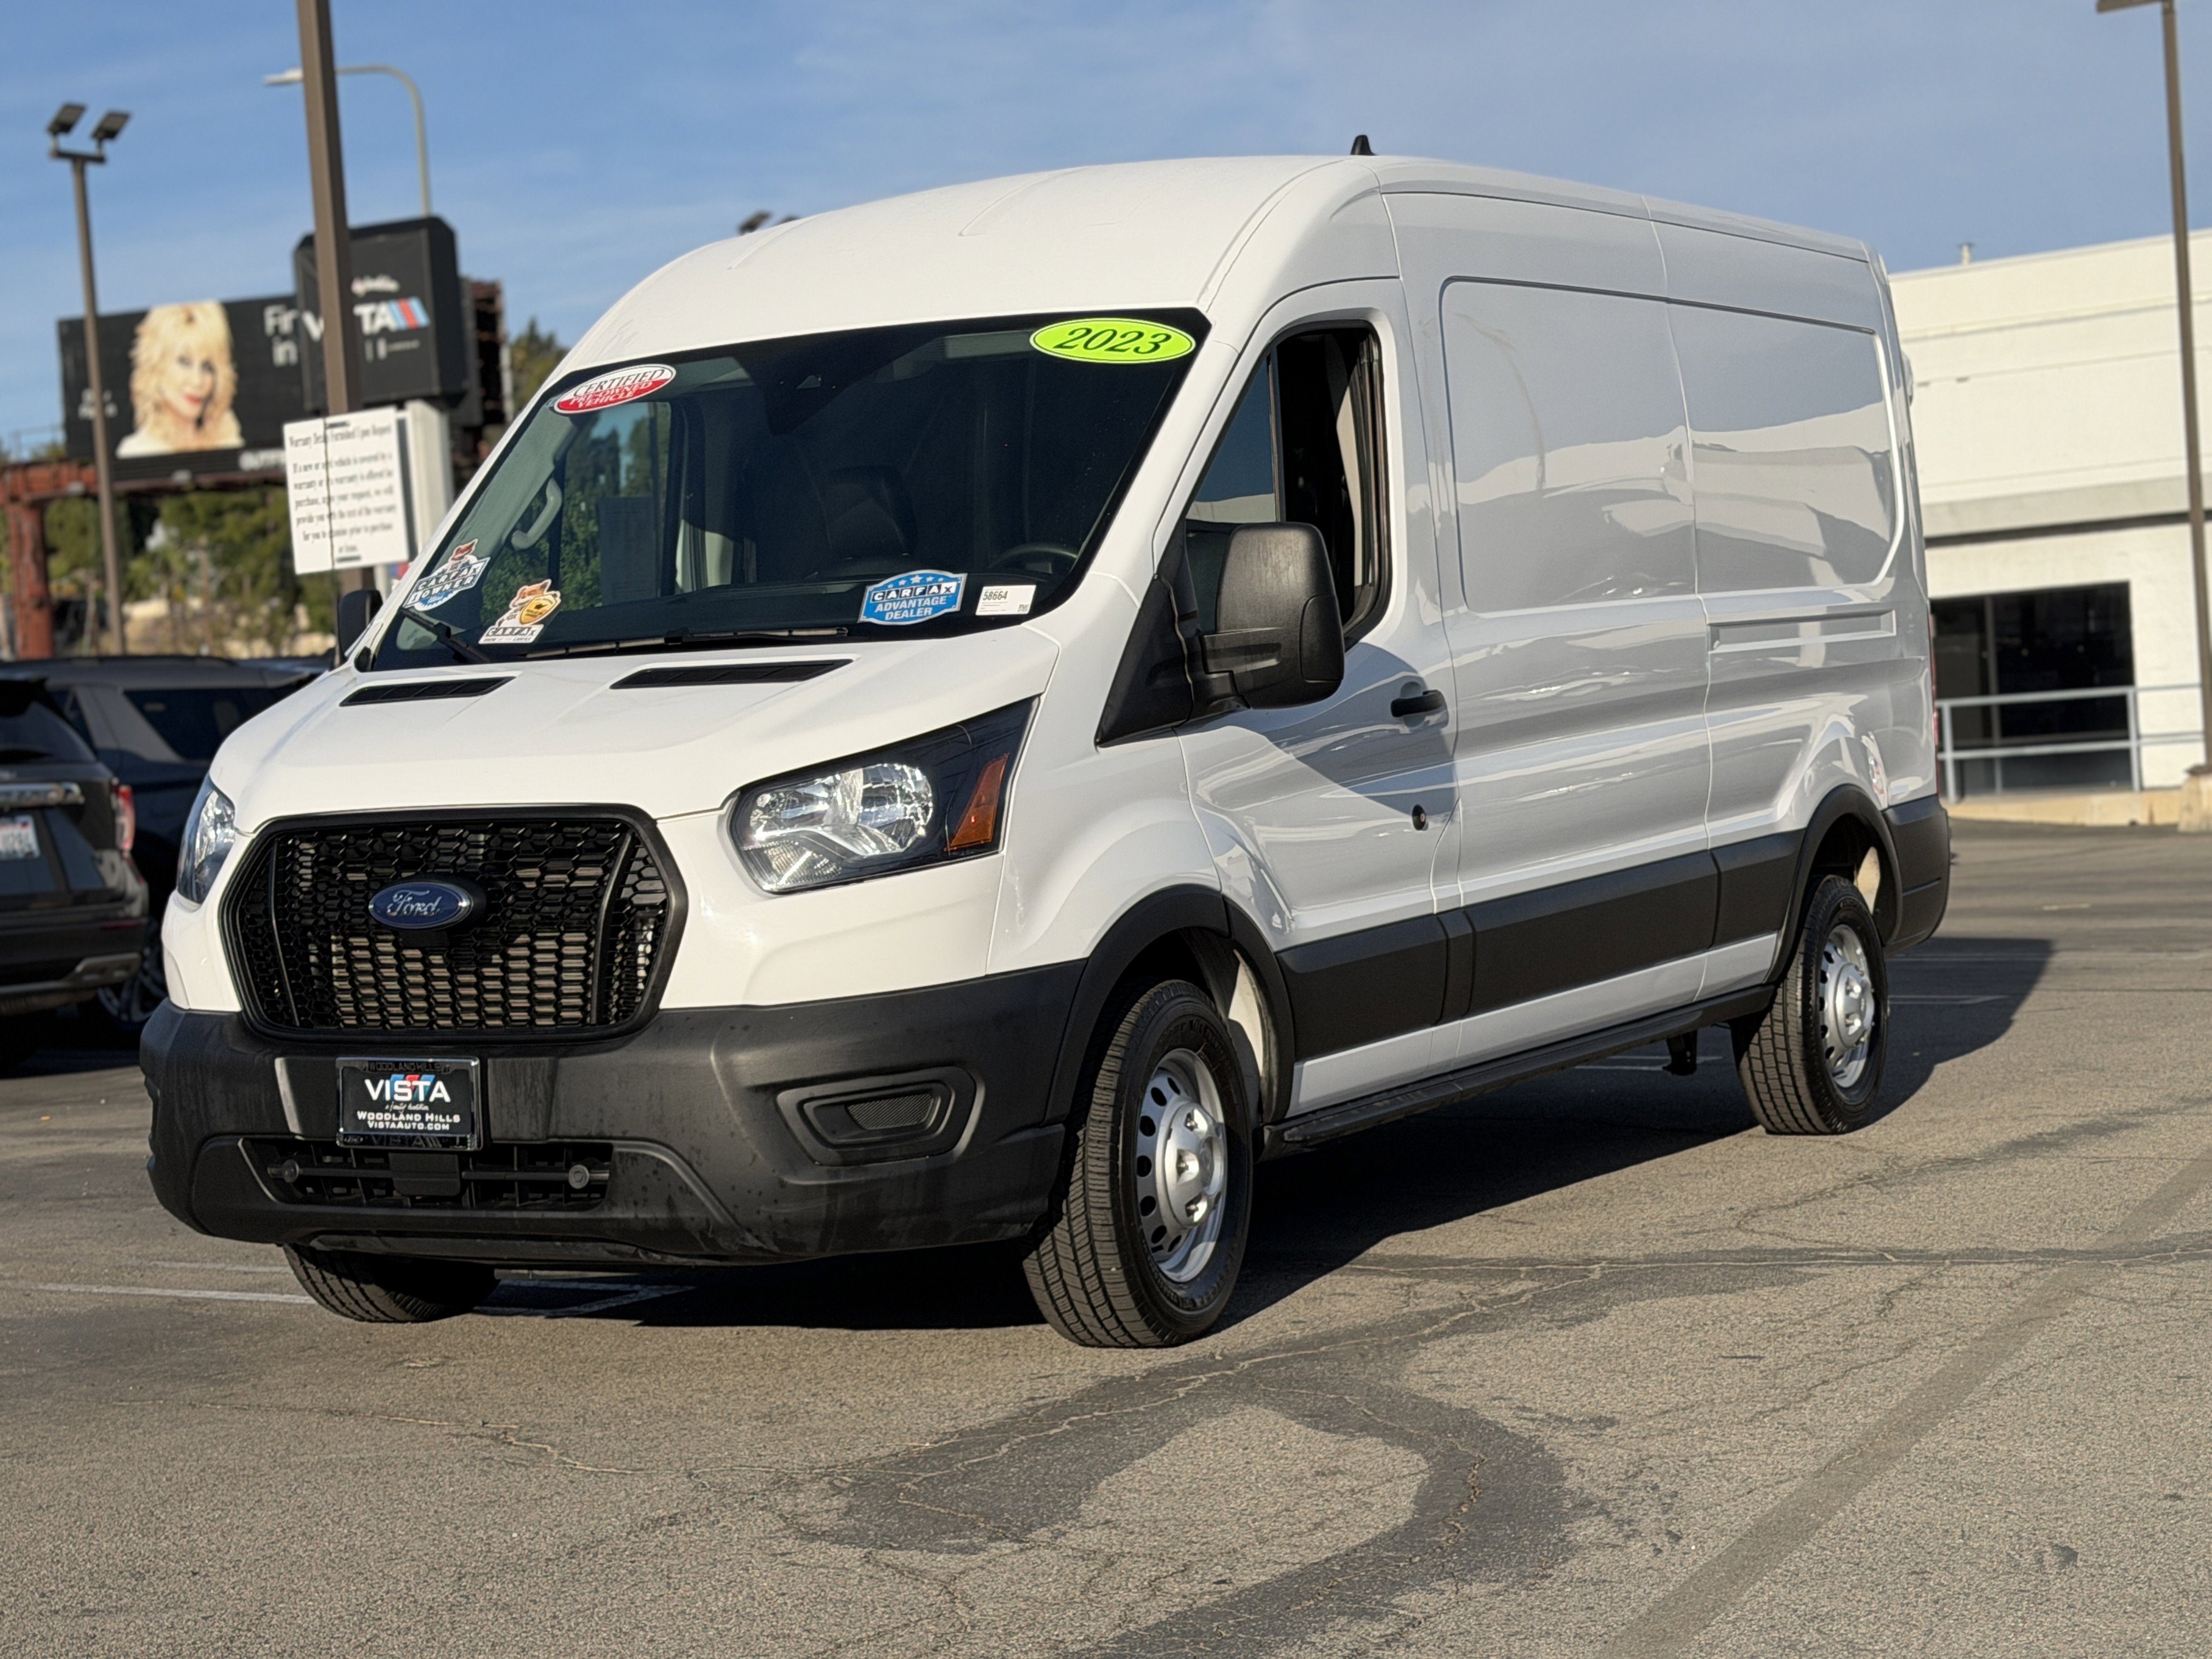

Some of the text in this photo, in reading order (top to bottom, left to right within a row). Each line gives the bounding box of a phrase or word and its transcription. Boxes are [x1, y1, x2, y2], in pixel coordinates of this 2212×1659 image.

[1052, 328, 1172, 354] 2023
[569, 381, 653, 405] PRE-OWNED
[573, 369, 665, 397] CERTIFIED
[578, 390, 636, 408] VEHICLE
[417, 566, 479, 590] CARFAX
[421, 575, 475, 598] OWNER
[872, 585, 953, 602] CARFAX
[983, 590, 1008, 601] 58664
[874, 596, 947, 613] ADVANTAGE
[884, 607, 933, 620] DEALER
[487, 627, 537, 636] CARFAX
[386, 889, 443, 917] Ford
[364, 1079, 451, 1103] VISTA
[357, 1110, 461, 1123] WOODLAND HILLS
